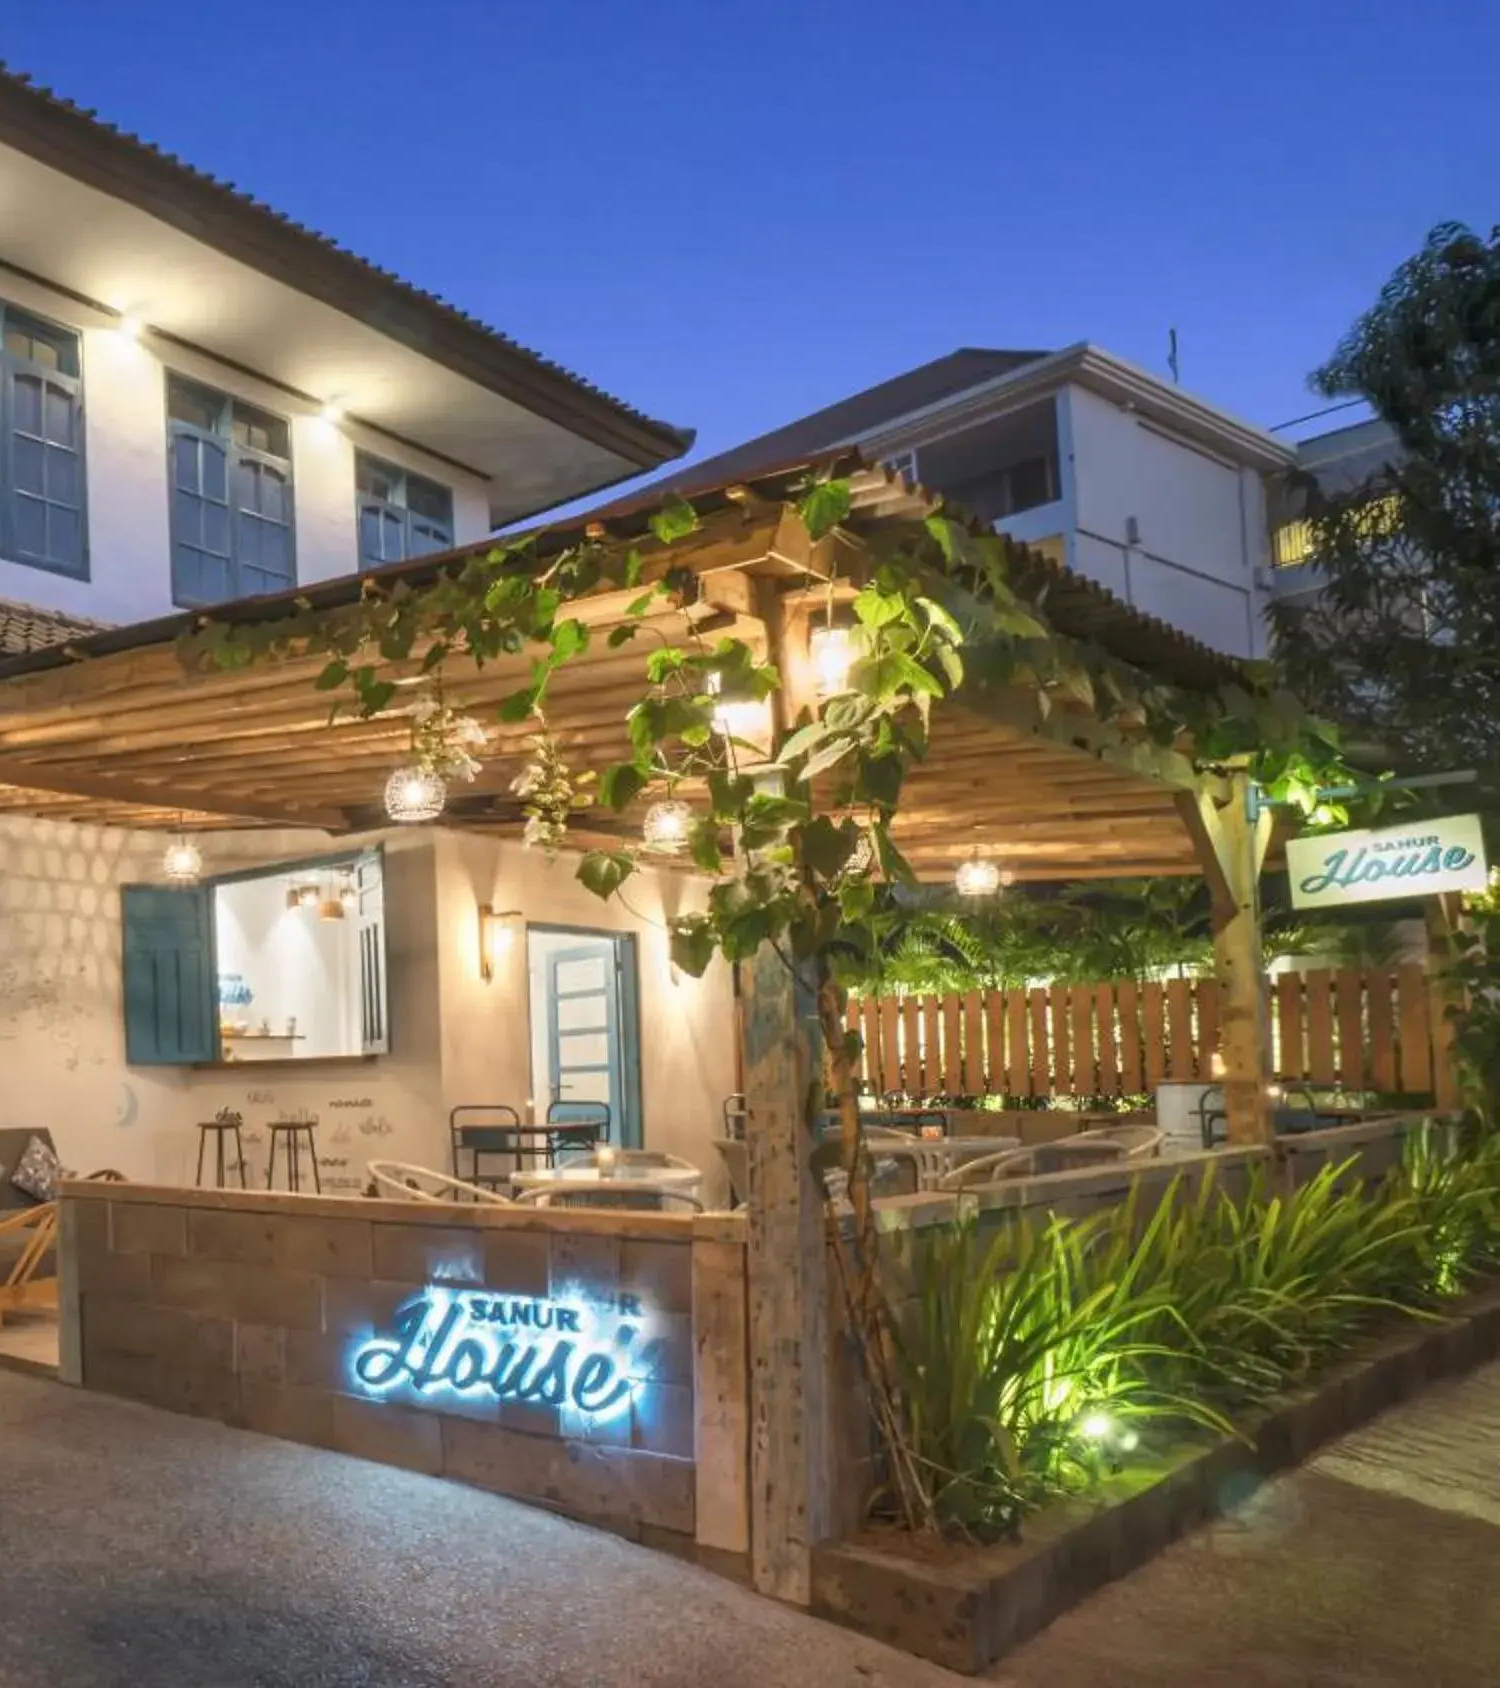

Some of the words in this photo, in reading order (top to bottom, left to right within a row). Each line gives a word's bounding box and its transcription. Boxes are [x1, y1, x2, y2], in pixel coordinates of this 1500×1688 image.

[1299, 846, 1476, 894] House
[469, 1298, 582, 1333] SANUR
[355, 1298, 633, 1412] House
